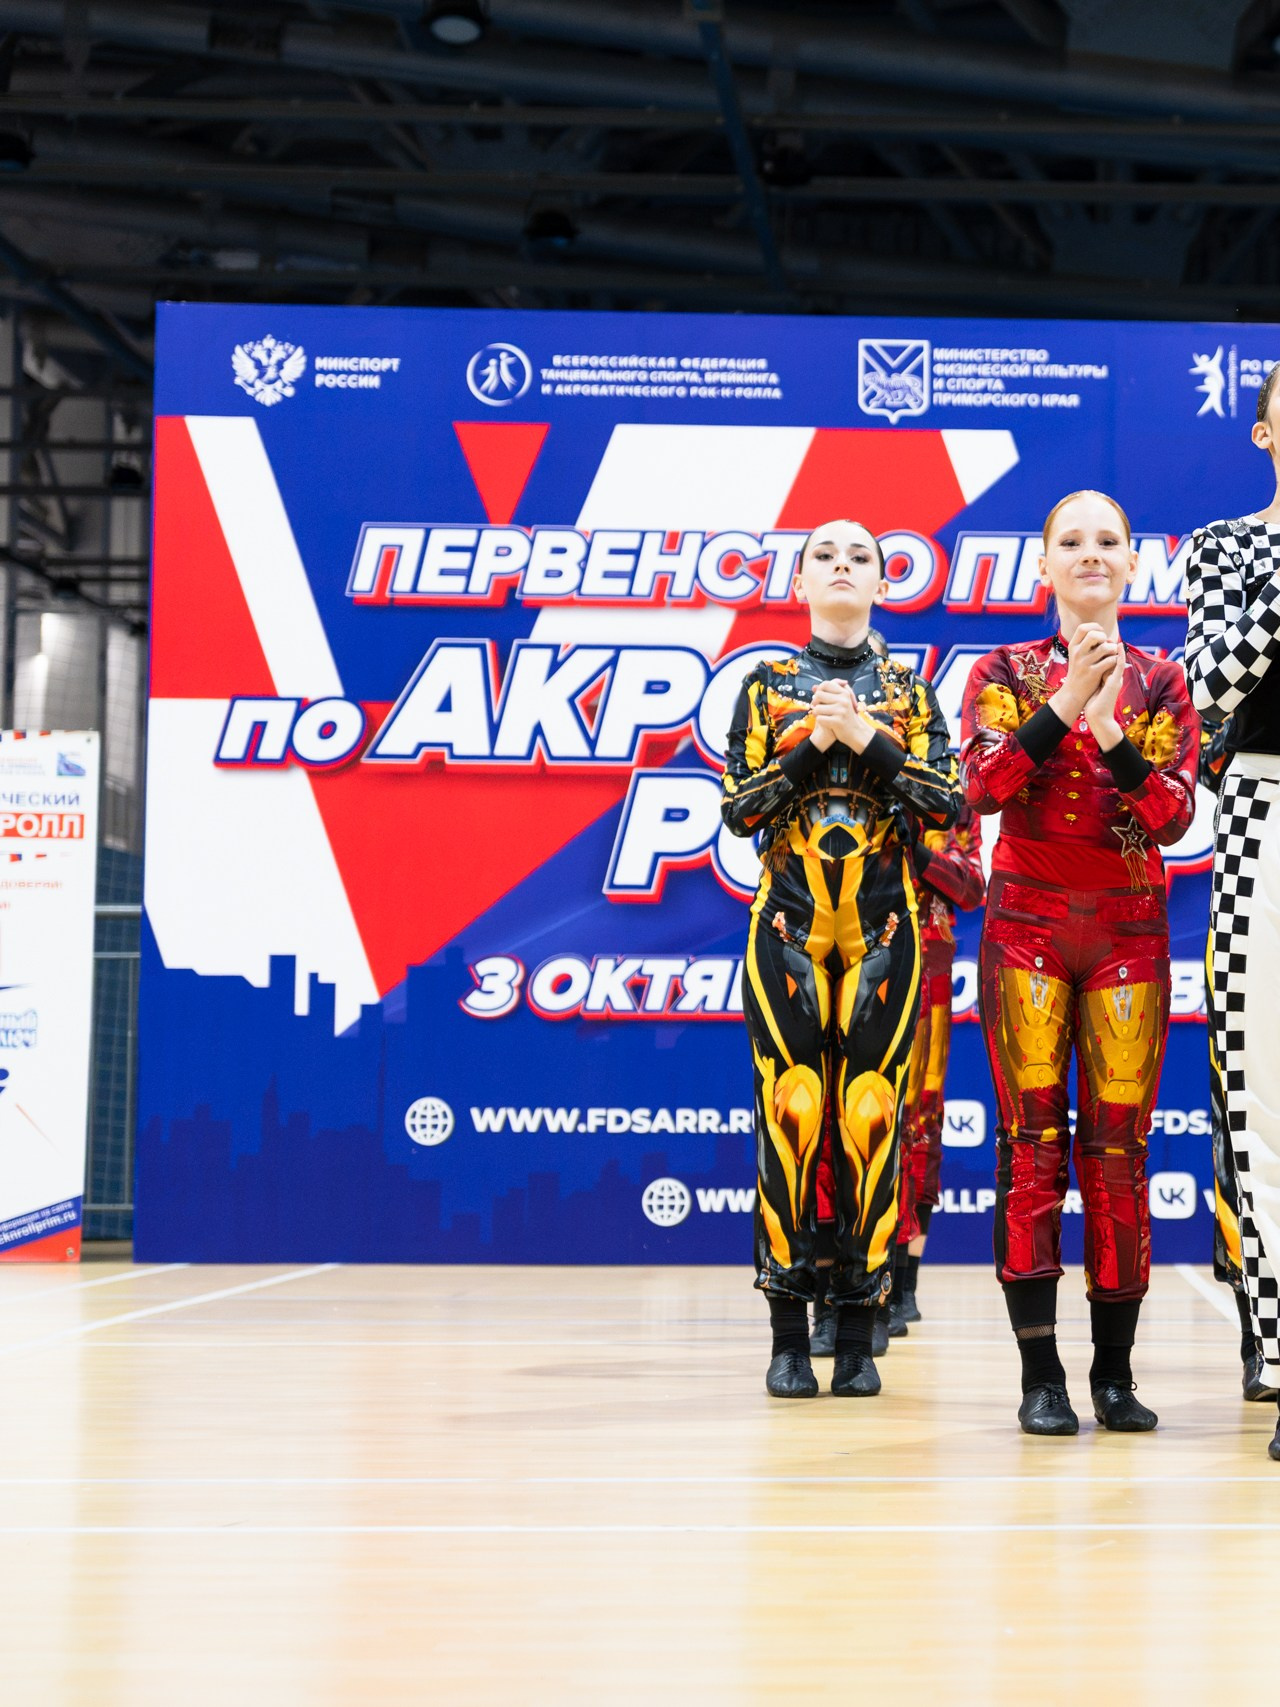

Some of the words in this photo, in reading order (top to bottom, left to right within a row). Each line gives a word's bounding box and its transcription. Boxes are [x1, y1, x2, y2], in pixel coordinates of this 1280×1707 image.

[552, 354, 677, 368] ВСЕРОССИЙСКАЯ
[680, 357, 768, 371] ФЕДЕРАЦИЯ
[933, 348, 1049, 363] МИНИСТЕРСТВО
[315, 356, 400, 372] МИНСПОРТ
[933, 362, 1031, 378] ФИЗИЧЕСКОЙ
[1032, 363, 1109, 379] КУЛЬТУРЫ
[315, 373, 381, 389] РОССИИ
[540, 368, 648, 382] ТАНЦЕВАЛЬНОГО
[703, 370, 780, 385] БРЕЙКИНГА
[933, 377, 945, 391] И
[946, 377, 1005, 392] СПОРТА
[540, 383, 552, 396] И
[554, 384, 688, 399] АКРОБАТИЧЕСКОГО
[933, 392, 1040, 408] ПРИМОРСКОГО
[1041, 394, 1081, 408] КРАЯ
[347, 524, 939, 604] ПЕРВЕНСТО
[461, 956, 522, 1014] 3
[530, 955, 746, 1014] ОКТЯ
